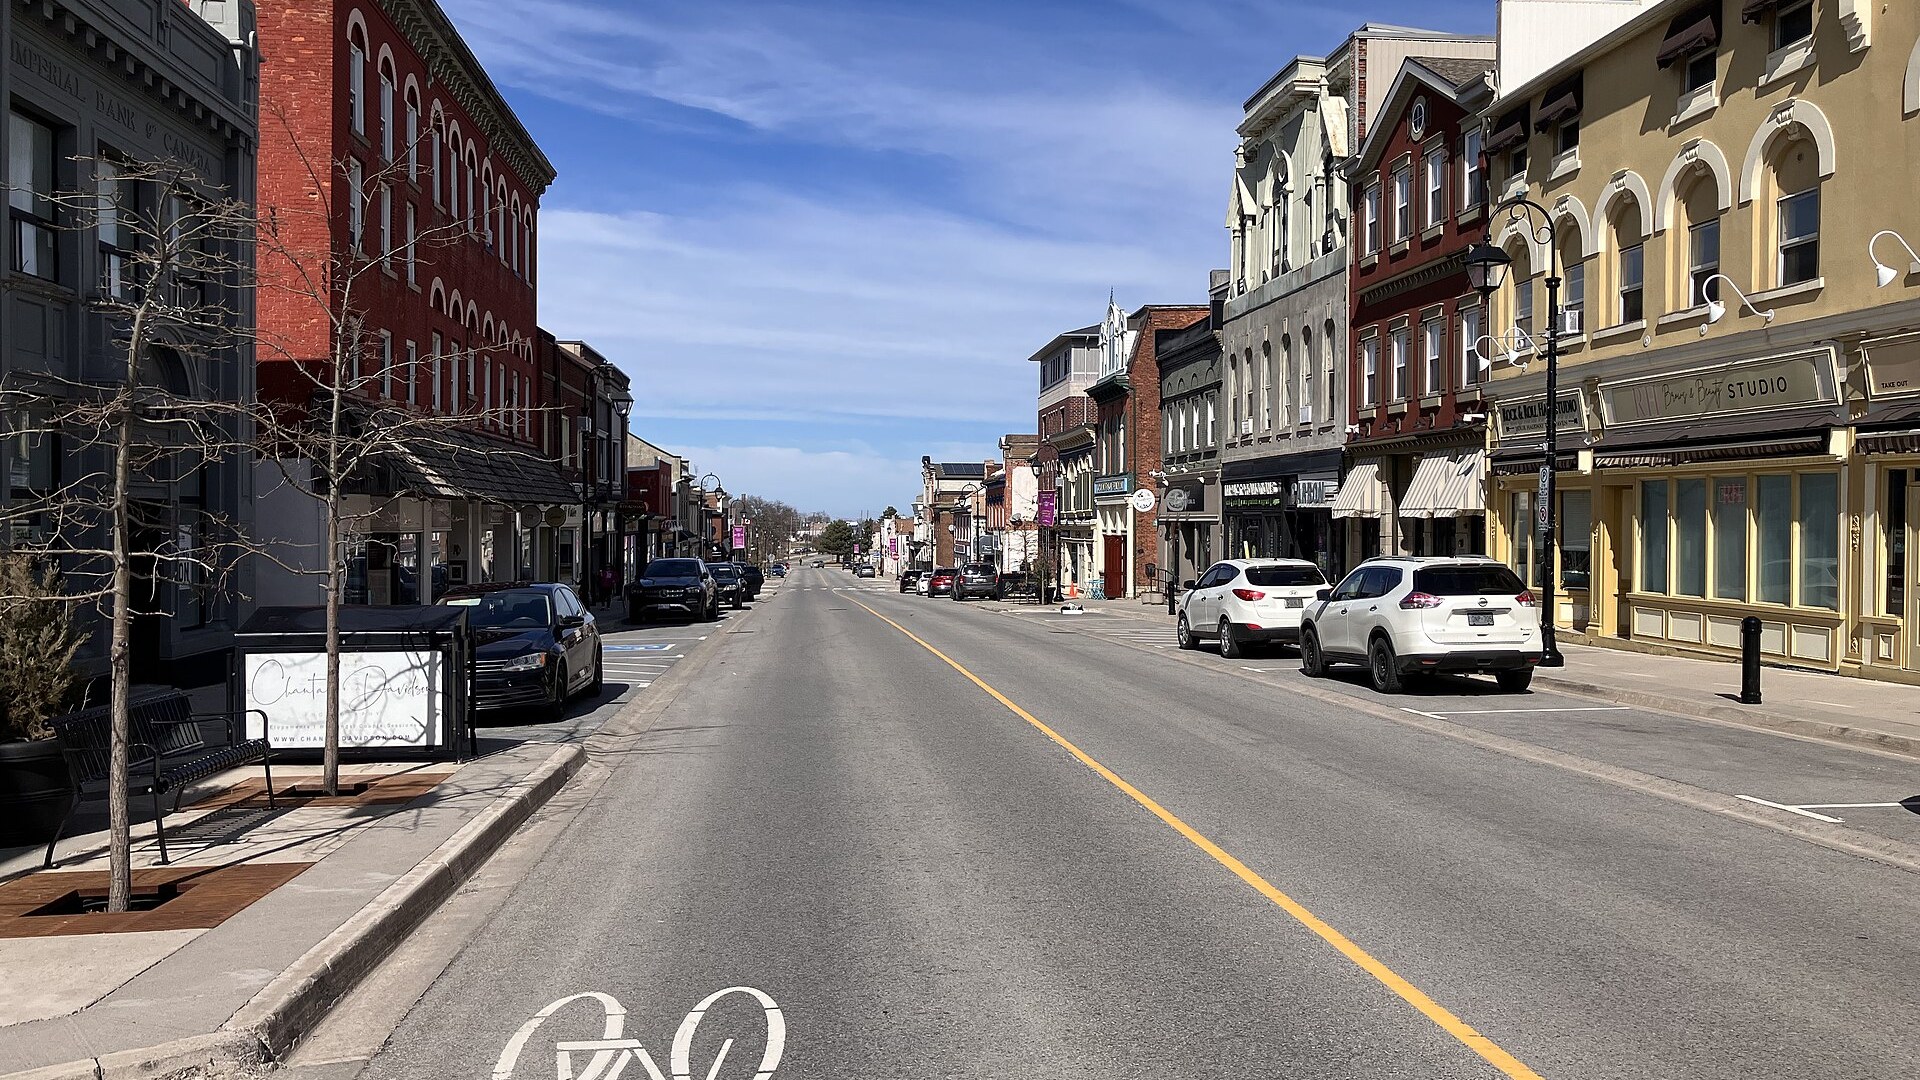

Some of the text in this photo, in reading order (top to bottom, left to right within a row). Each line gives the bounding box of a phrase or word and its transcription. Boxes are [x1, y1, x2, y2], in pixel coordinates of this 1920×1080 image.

[10, 38, 86, 102] IMPERIAL
[96, 90, 137, 134] BANK
[163, 133, 212, 177] CANADA
[1632, 384, 1661, 418] RH
[1694, 378, 1724, 409] Beauty
[1727, 376, 1788, 399] STUDIO
[1881, 380, 1908, 389] TAKE OUT
[252, 659, 435, 711] Chanta Davidson
